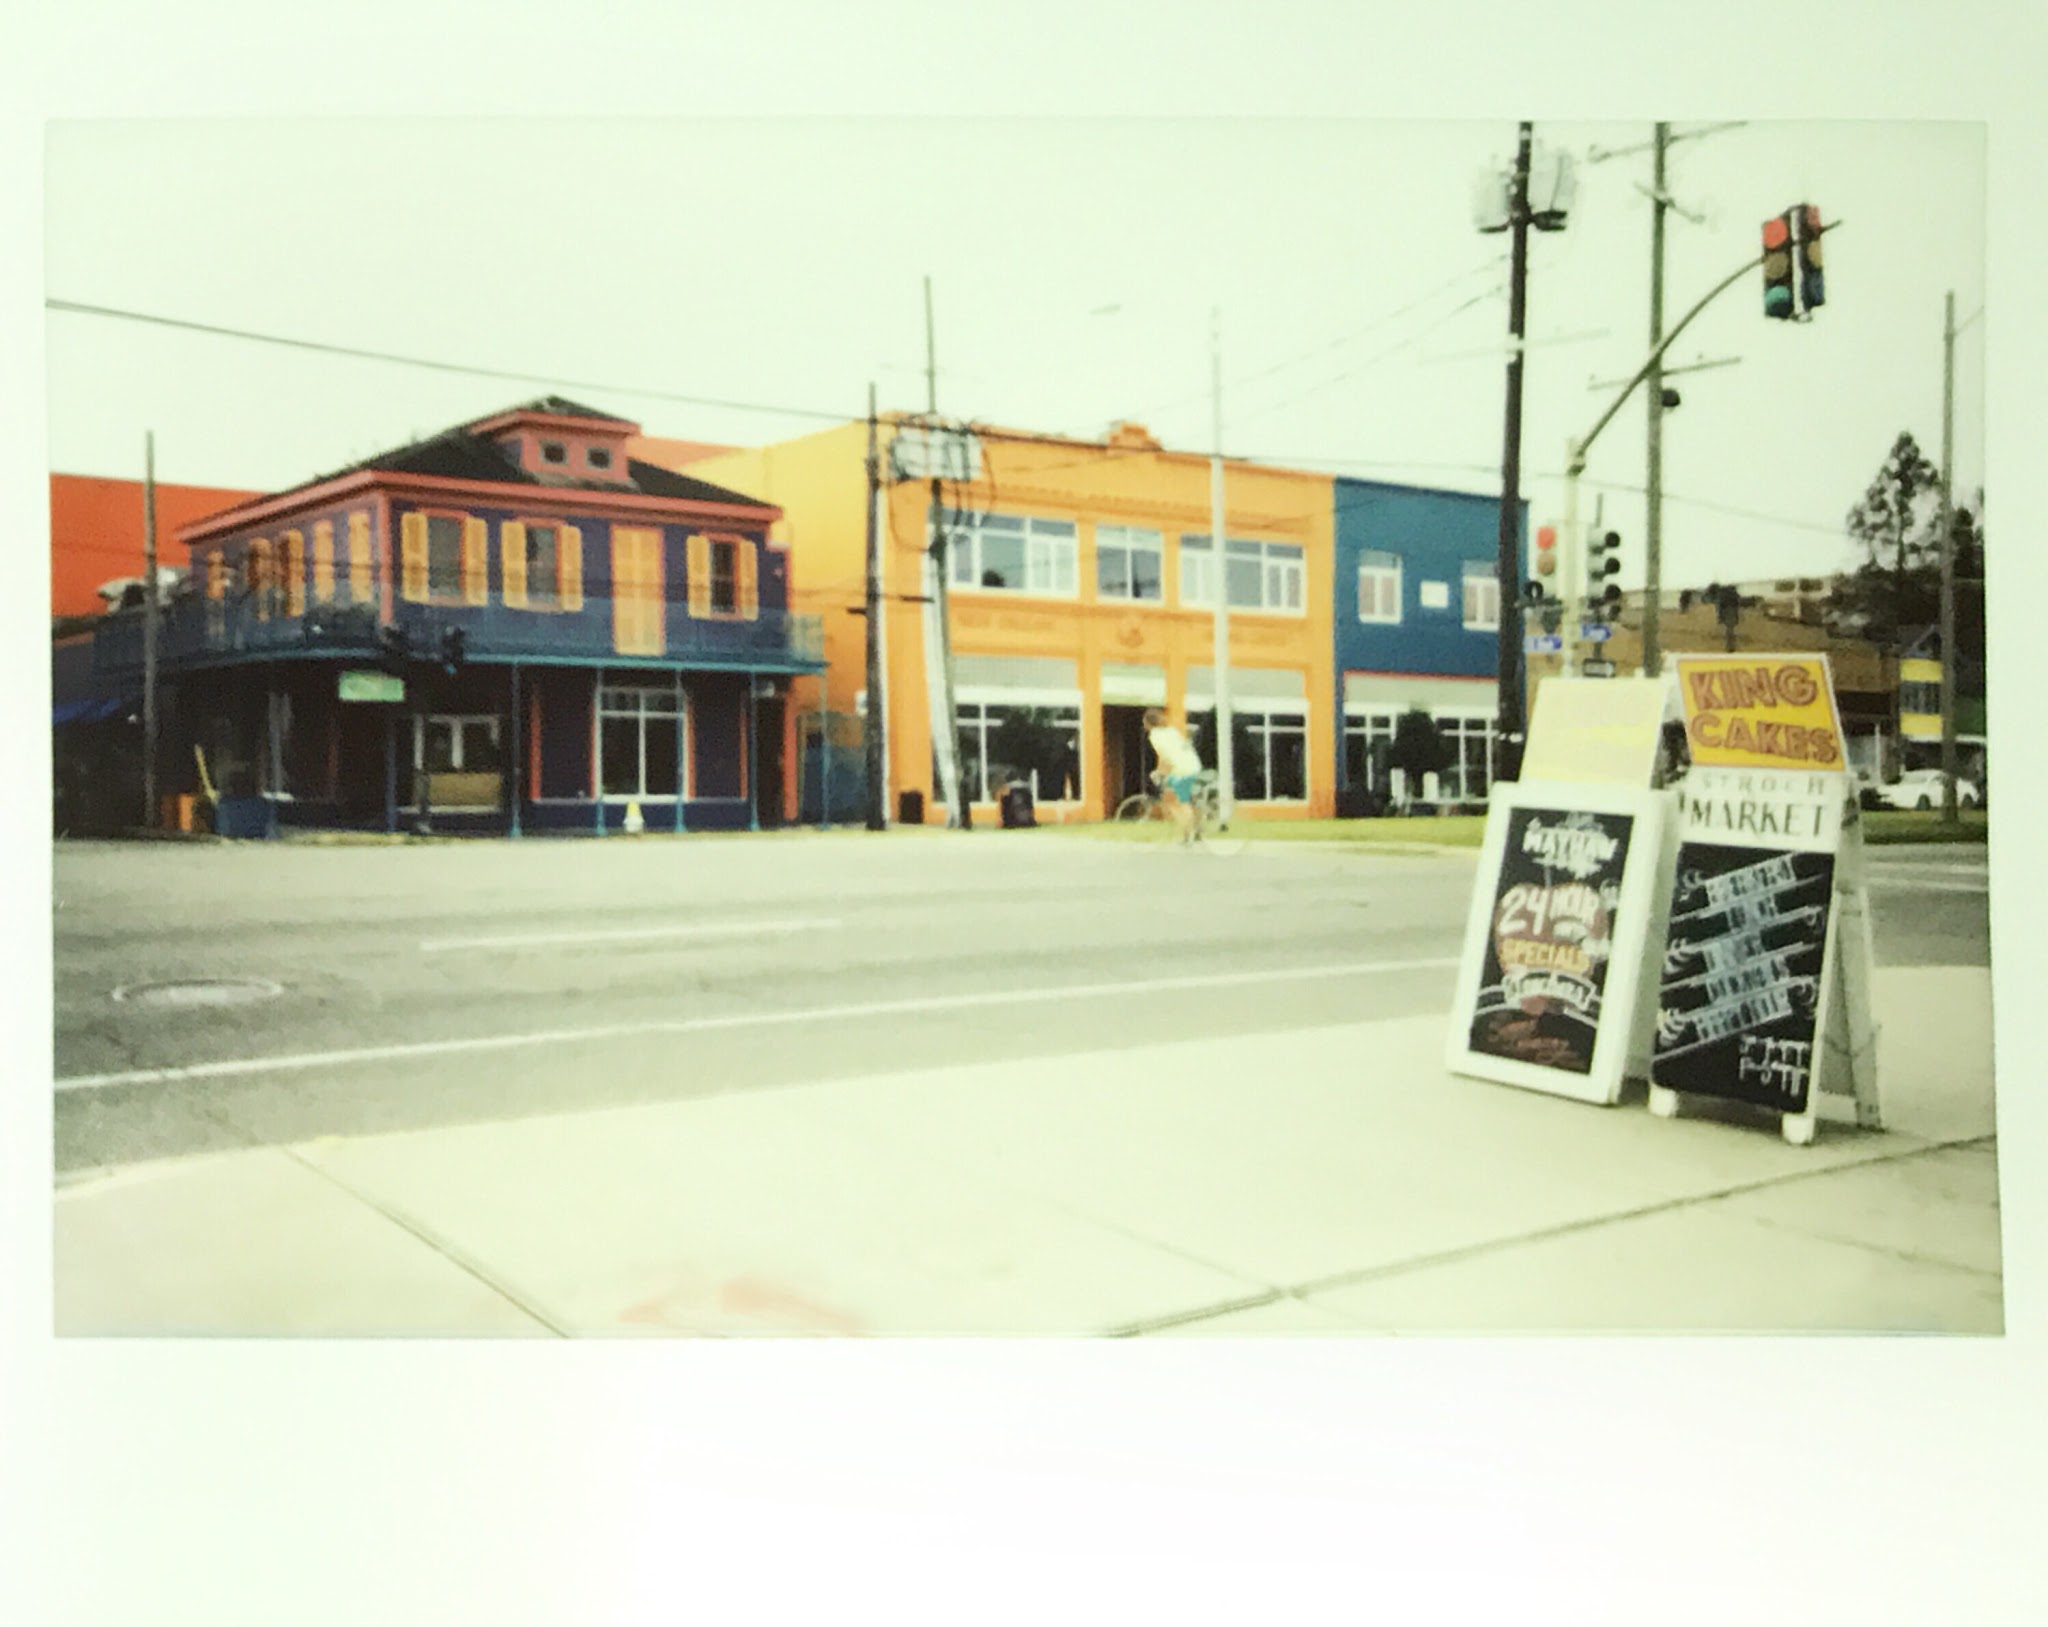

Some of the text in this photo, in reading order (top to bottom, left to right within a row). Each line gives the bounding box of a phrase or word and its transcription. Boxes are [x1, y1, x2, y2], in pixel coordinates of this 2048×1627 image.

[1689, 664, 1818, 711] KING
[1690, 713, 1839, 764] CAKES
[1690, 799, 1826, 838] MARKET
[1497, 885, 1549, 936] 24
